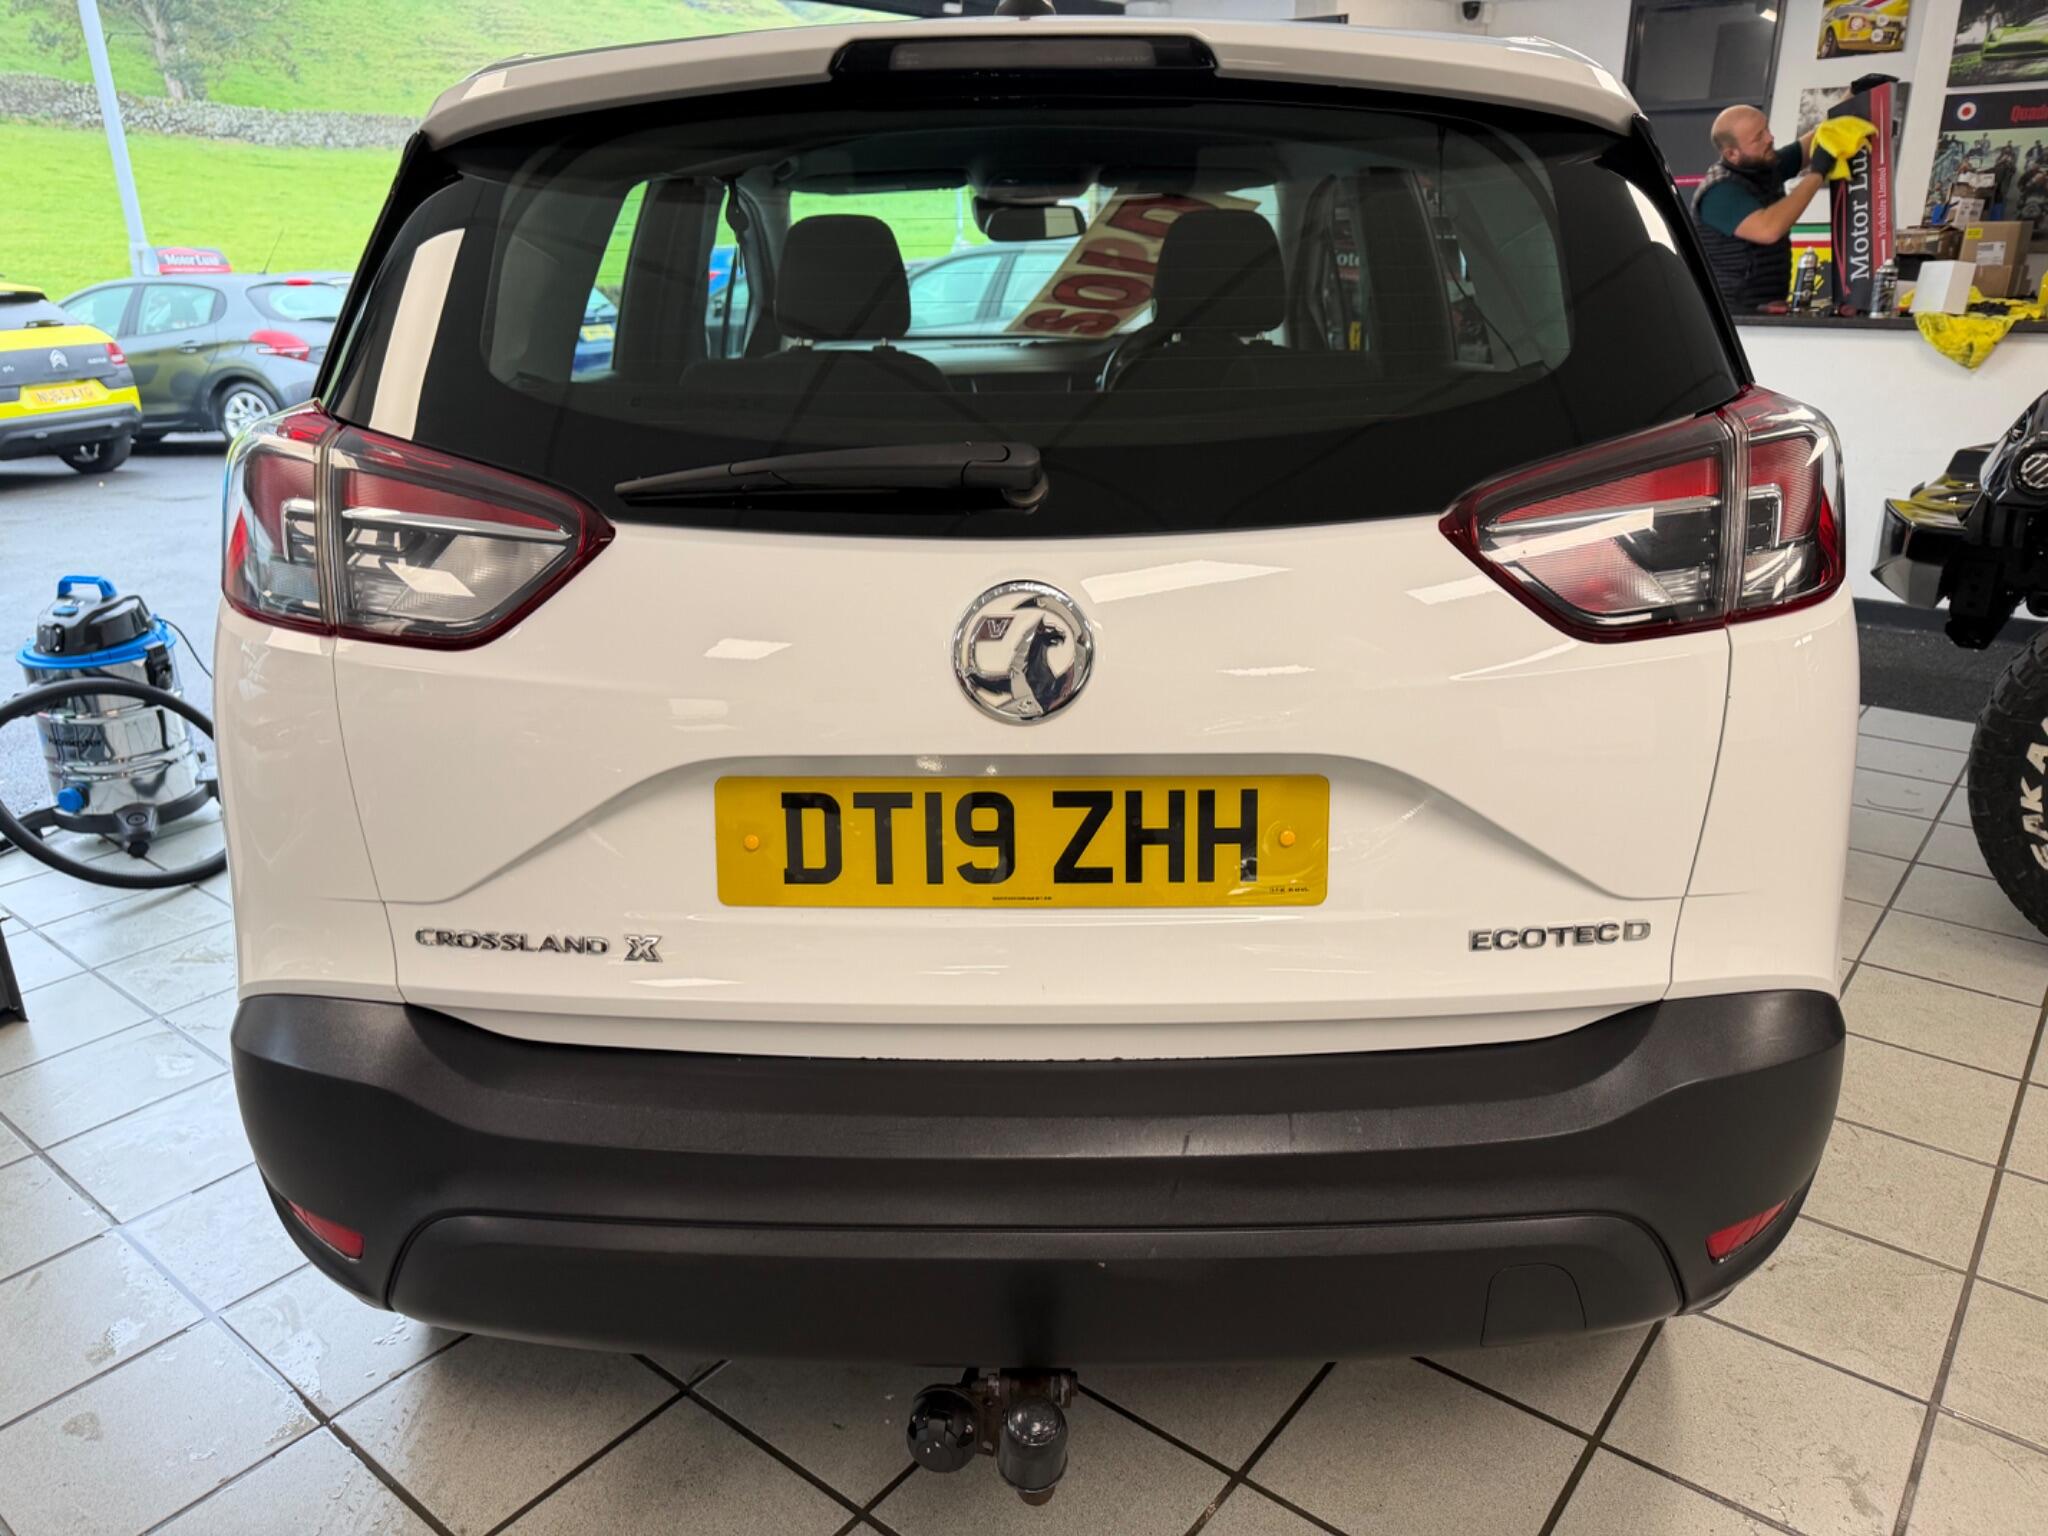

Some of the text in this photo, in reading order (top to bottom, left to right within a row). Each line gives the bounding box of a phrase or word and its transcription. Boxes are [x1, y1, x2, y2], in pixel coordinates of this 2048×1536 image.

[1848, 199, 1870, 282] Motor
[1878, 166, 1887, 238] Yorkshire Limited
[781, 789, 1259, 885] DT19 ZHH
[414, 928, 663, 963] CROSSLAND X
